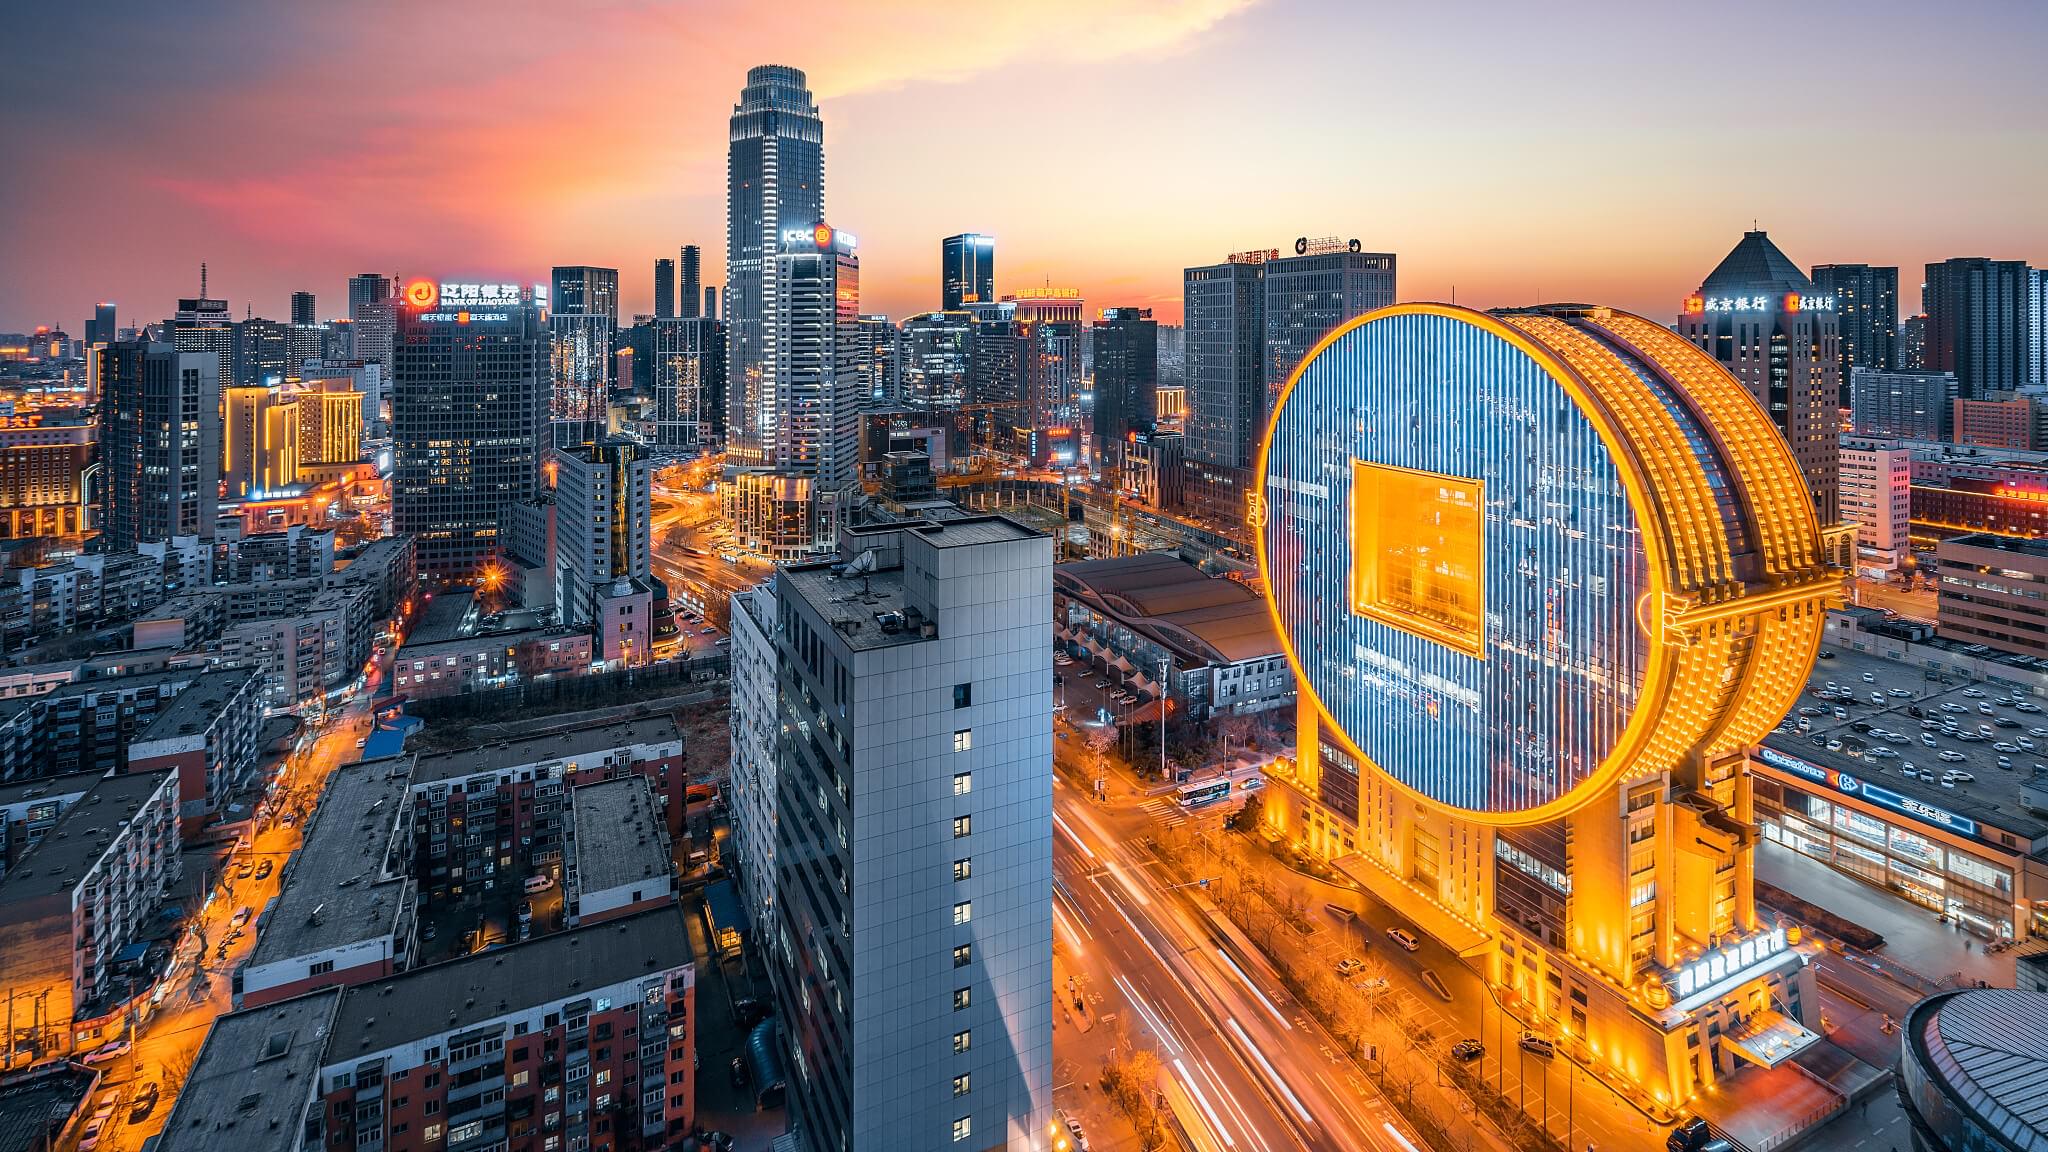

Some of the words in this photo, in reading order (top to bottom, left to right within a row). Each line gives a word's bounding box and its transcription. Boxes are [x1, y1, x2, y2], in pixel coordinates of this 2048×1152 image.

[784, 230, 814, 241] ICBC
[441, 284, 519, 298] 辽阳银行
[1763, 749, 1825, 778] Carrefour
